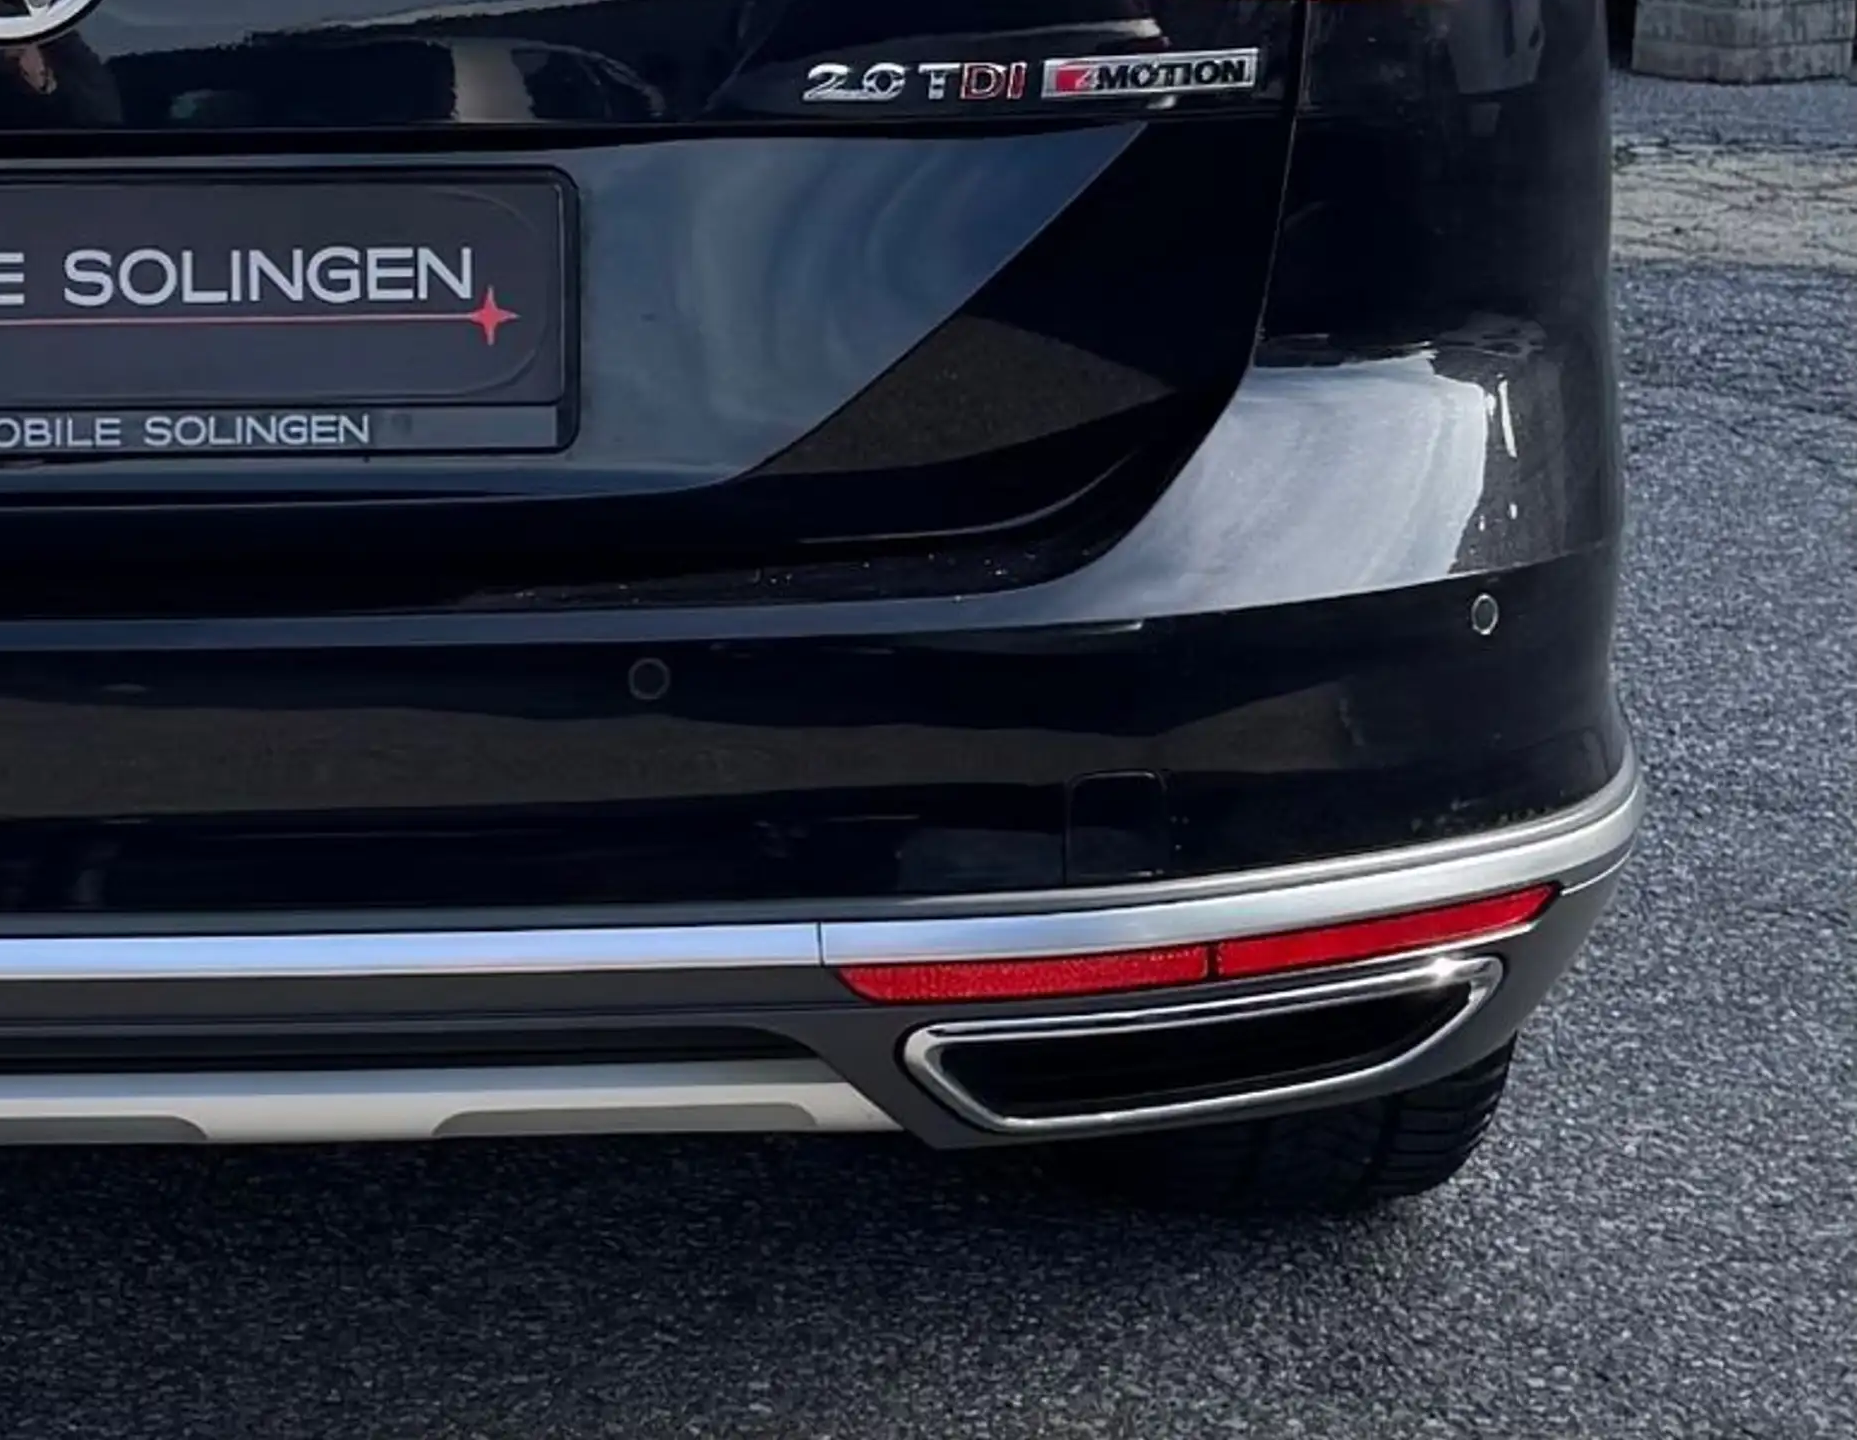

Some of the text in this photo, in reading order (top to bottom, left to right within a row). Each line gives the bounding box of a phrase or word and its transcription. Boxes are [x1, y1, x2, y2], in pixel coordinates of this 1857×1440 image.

[918, 62, 1027, 100] TDI
[62, 247, 474, 308] SOLINGEN
[143, 414, 370, 447] SOLINGEN
